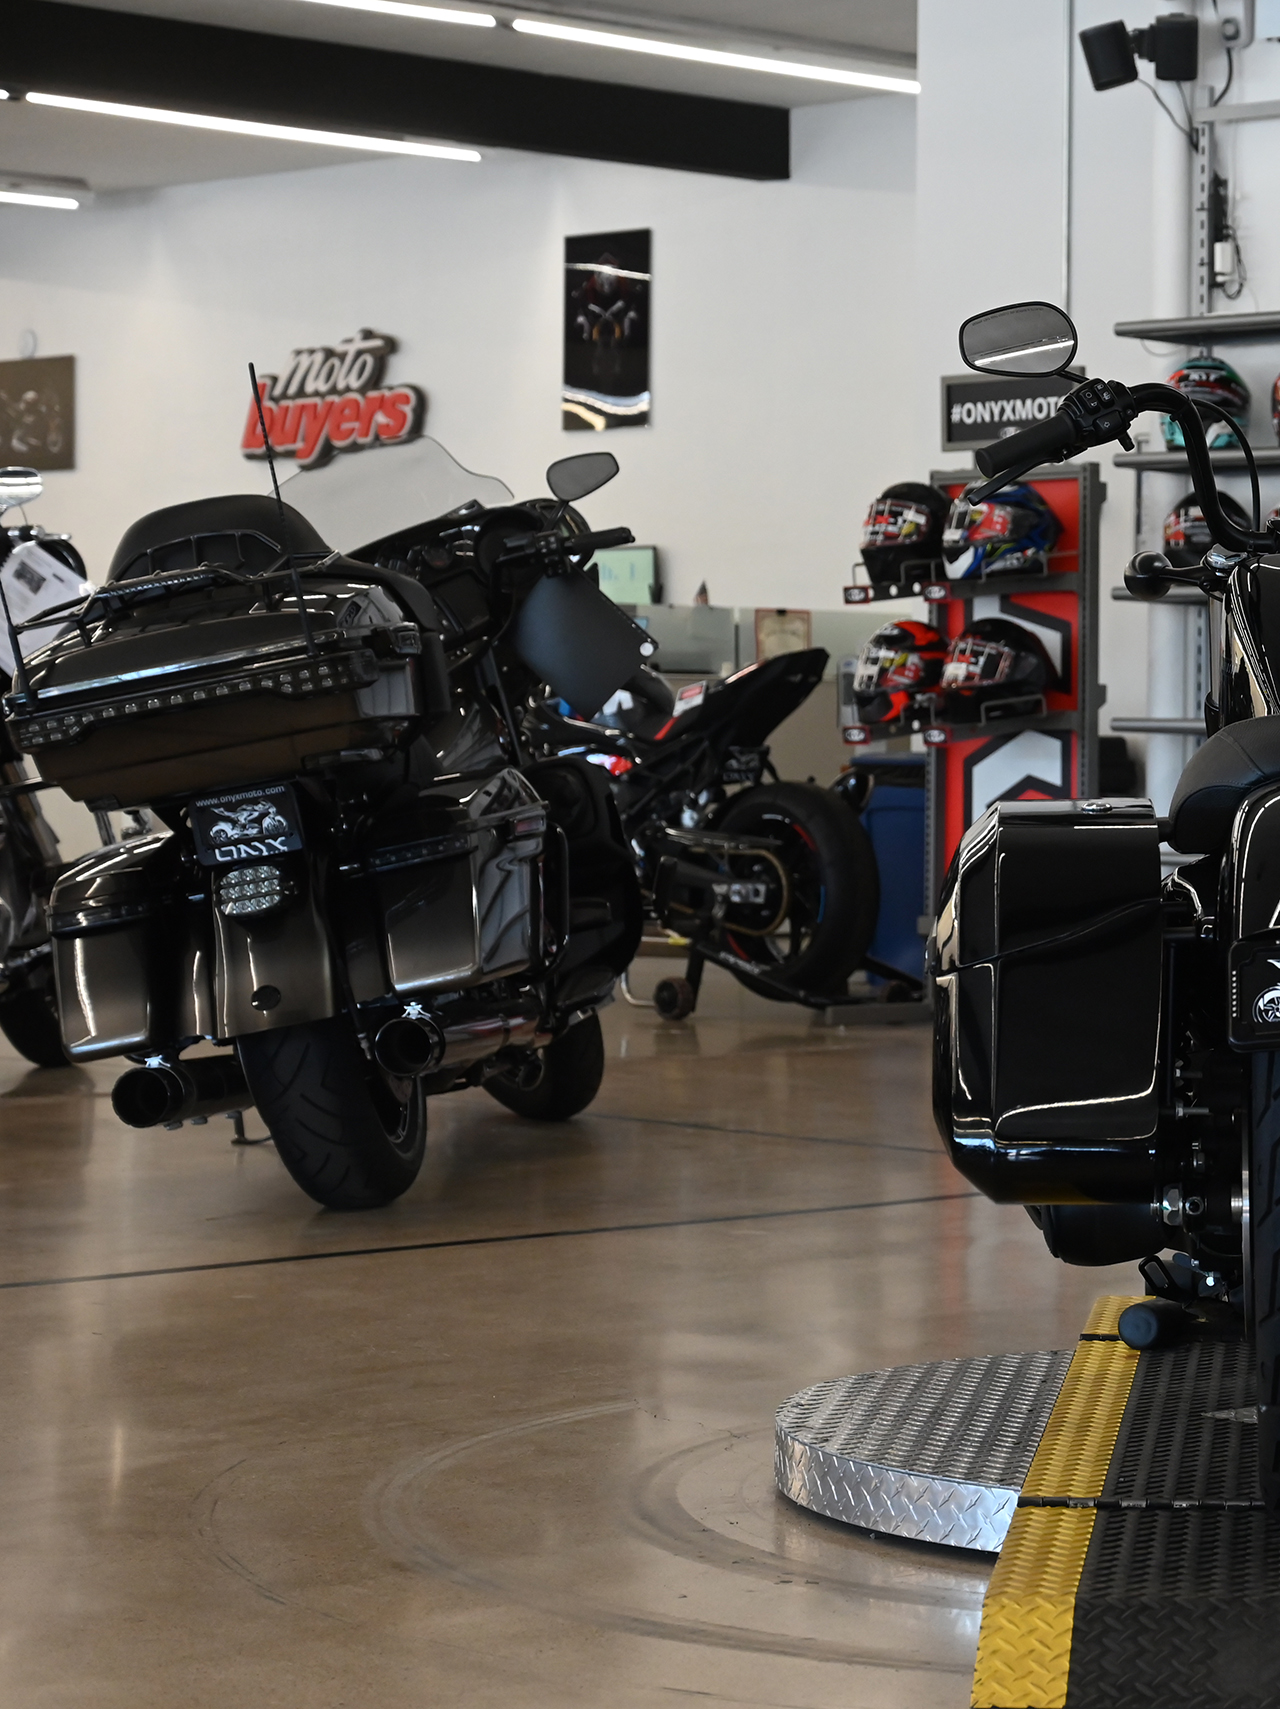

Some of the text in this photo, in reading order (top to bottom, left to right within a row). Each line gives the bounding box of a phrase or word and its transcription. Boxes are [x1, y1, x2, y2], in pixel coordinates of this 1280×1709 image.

[241, 379, 413, 462] buyers
[950, 395, 1067, 425] #ONYXMOT
[195, 785, 285, 807] www.onyxmoto.com
[215, 836, 288, 861] ONYX
